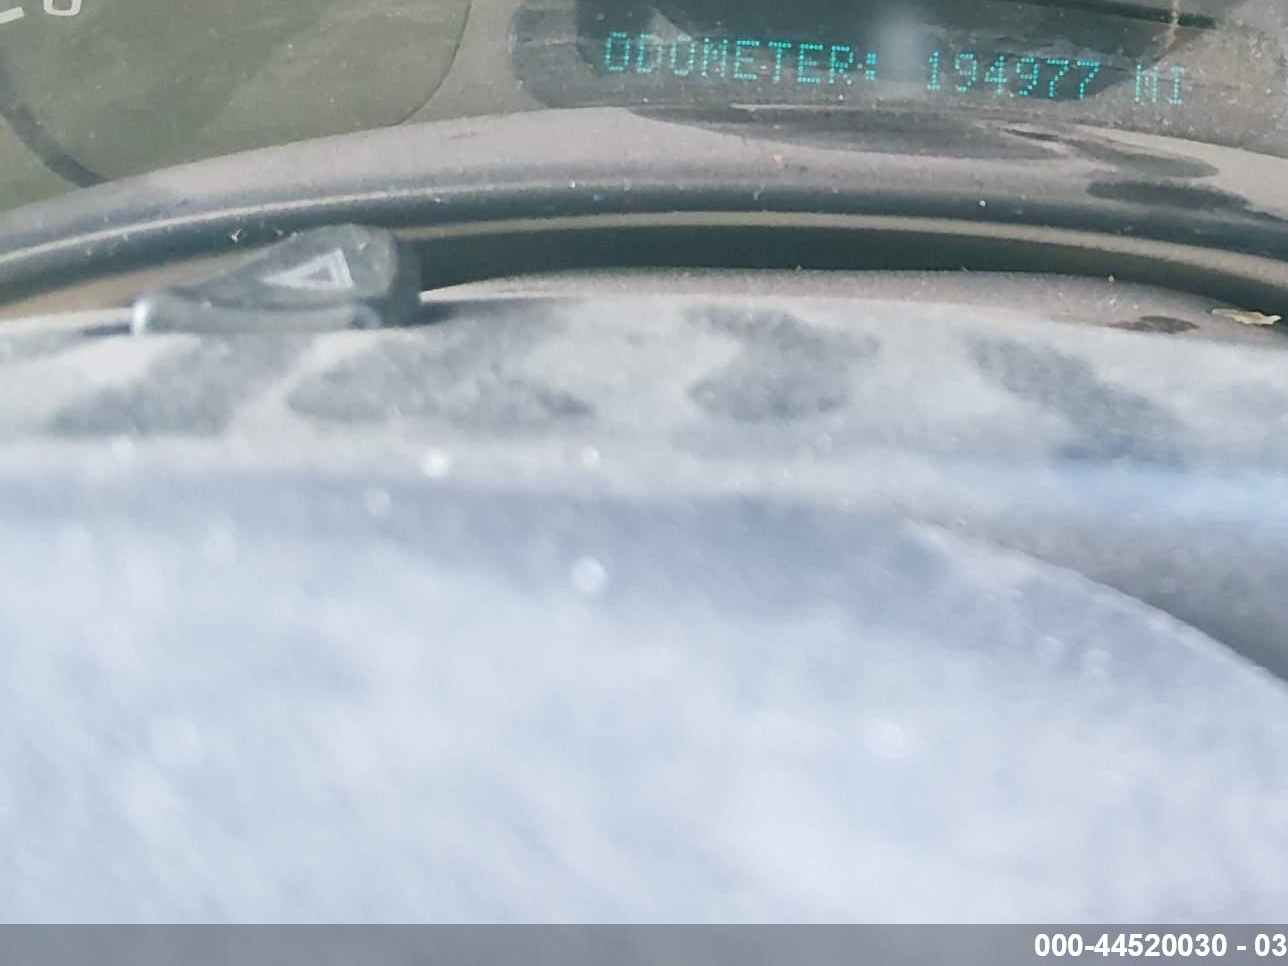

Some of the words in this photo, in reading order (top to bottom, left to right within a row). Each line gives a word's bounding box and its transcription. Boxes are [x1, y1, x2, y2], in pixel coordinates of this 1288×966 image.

[604, 31, 877, 85] ODOMETER:
[926, 50, 1100, 100] 194977
[1133, 63, 1185, 105] MI
